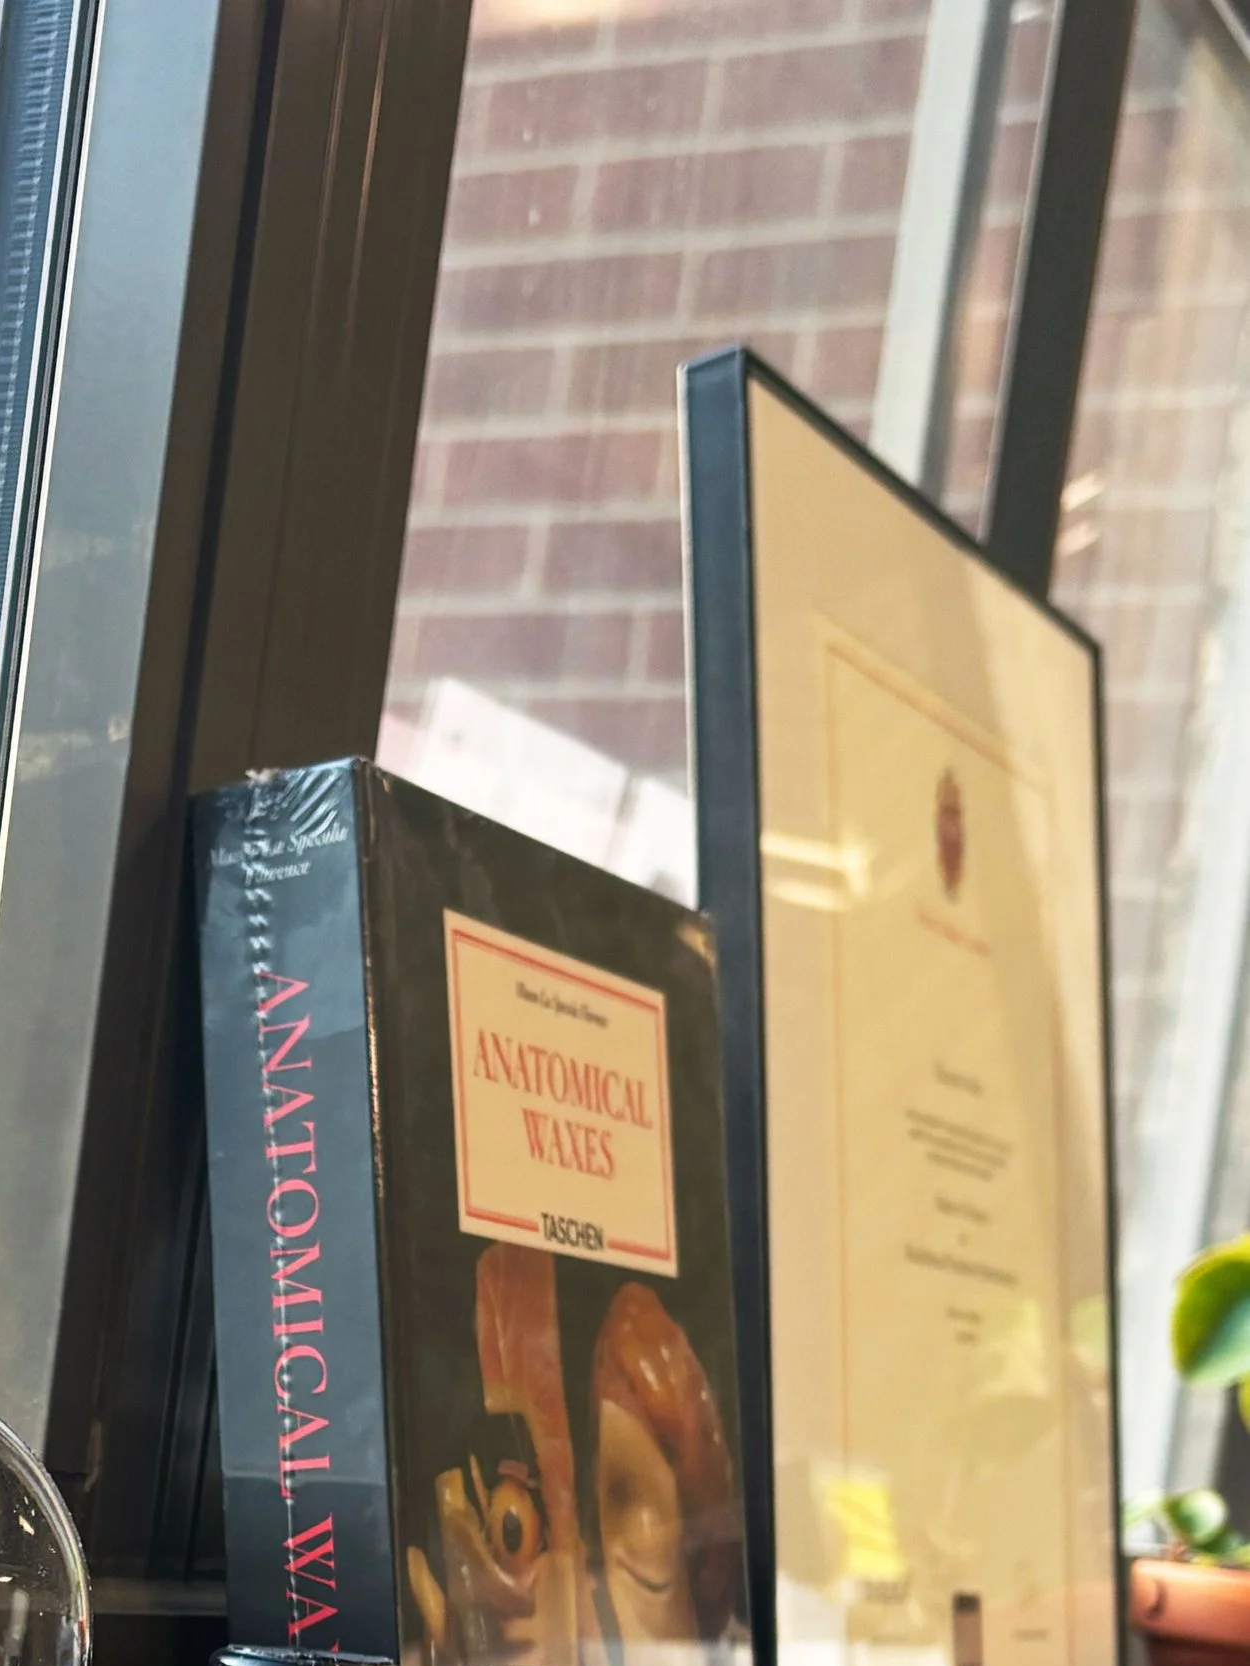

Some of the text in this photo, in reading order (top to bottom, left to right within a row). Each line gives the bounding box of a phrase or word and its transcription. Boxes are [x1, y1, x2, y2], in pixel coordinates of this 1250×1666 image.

[473, 1028, 654, 1130] ANATOMICAL
[521, 1107, 616, 1181] WAXES
[541, 1211, 605, 1252] TASCHEN
[255, 970, 341, 1654] ANATOMICAL WA
